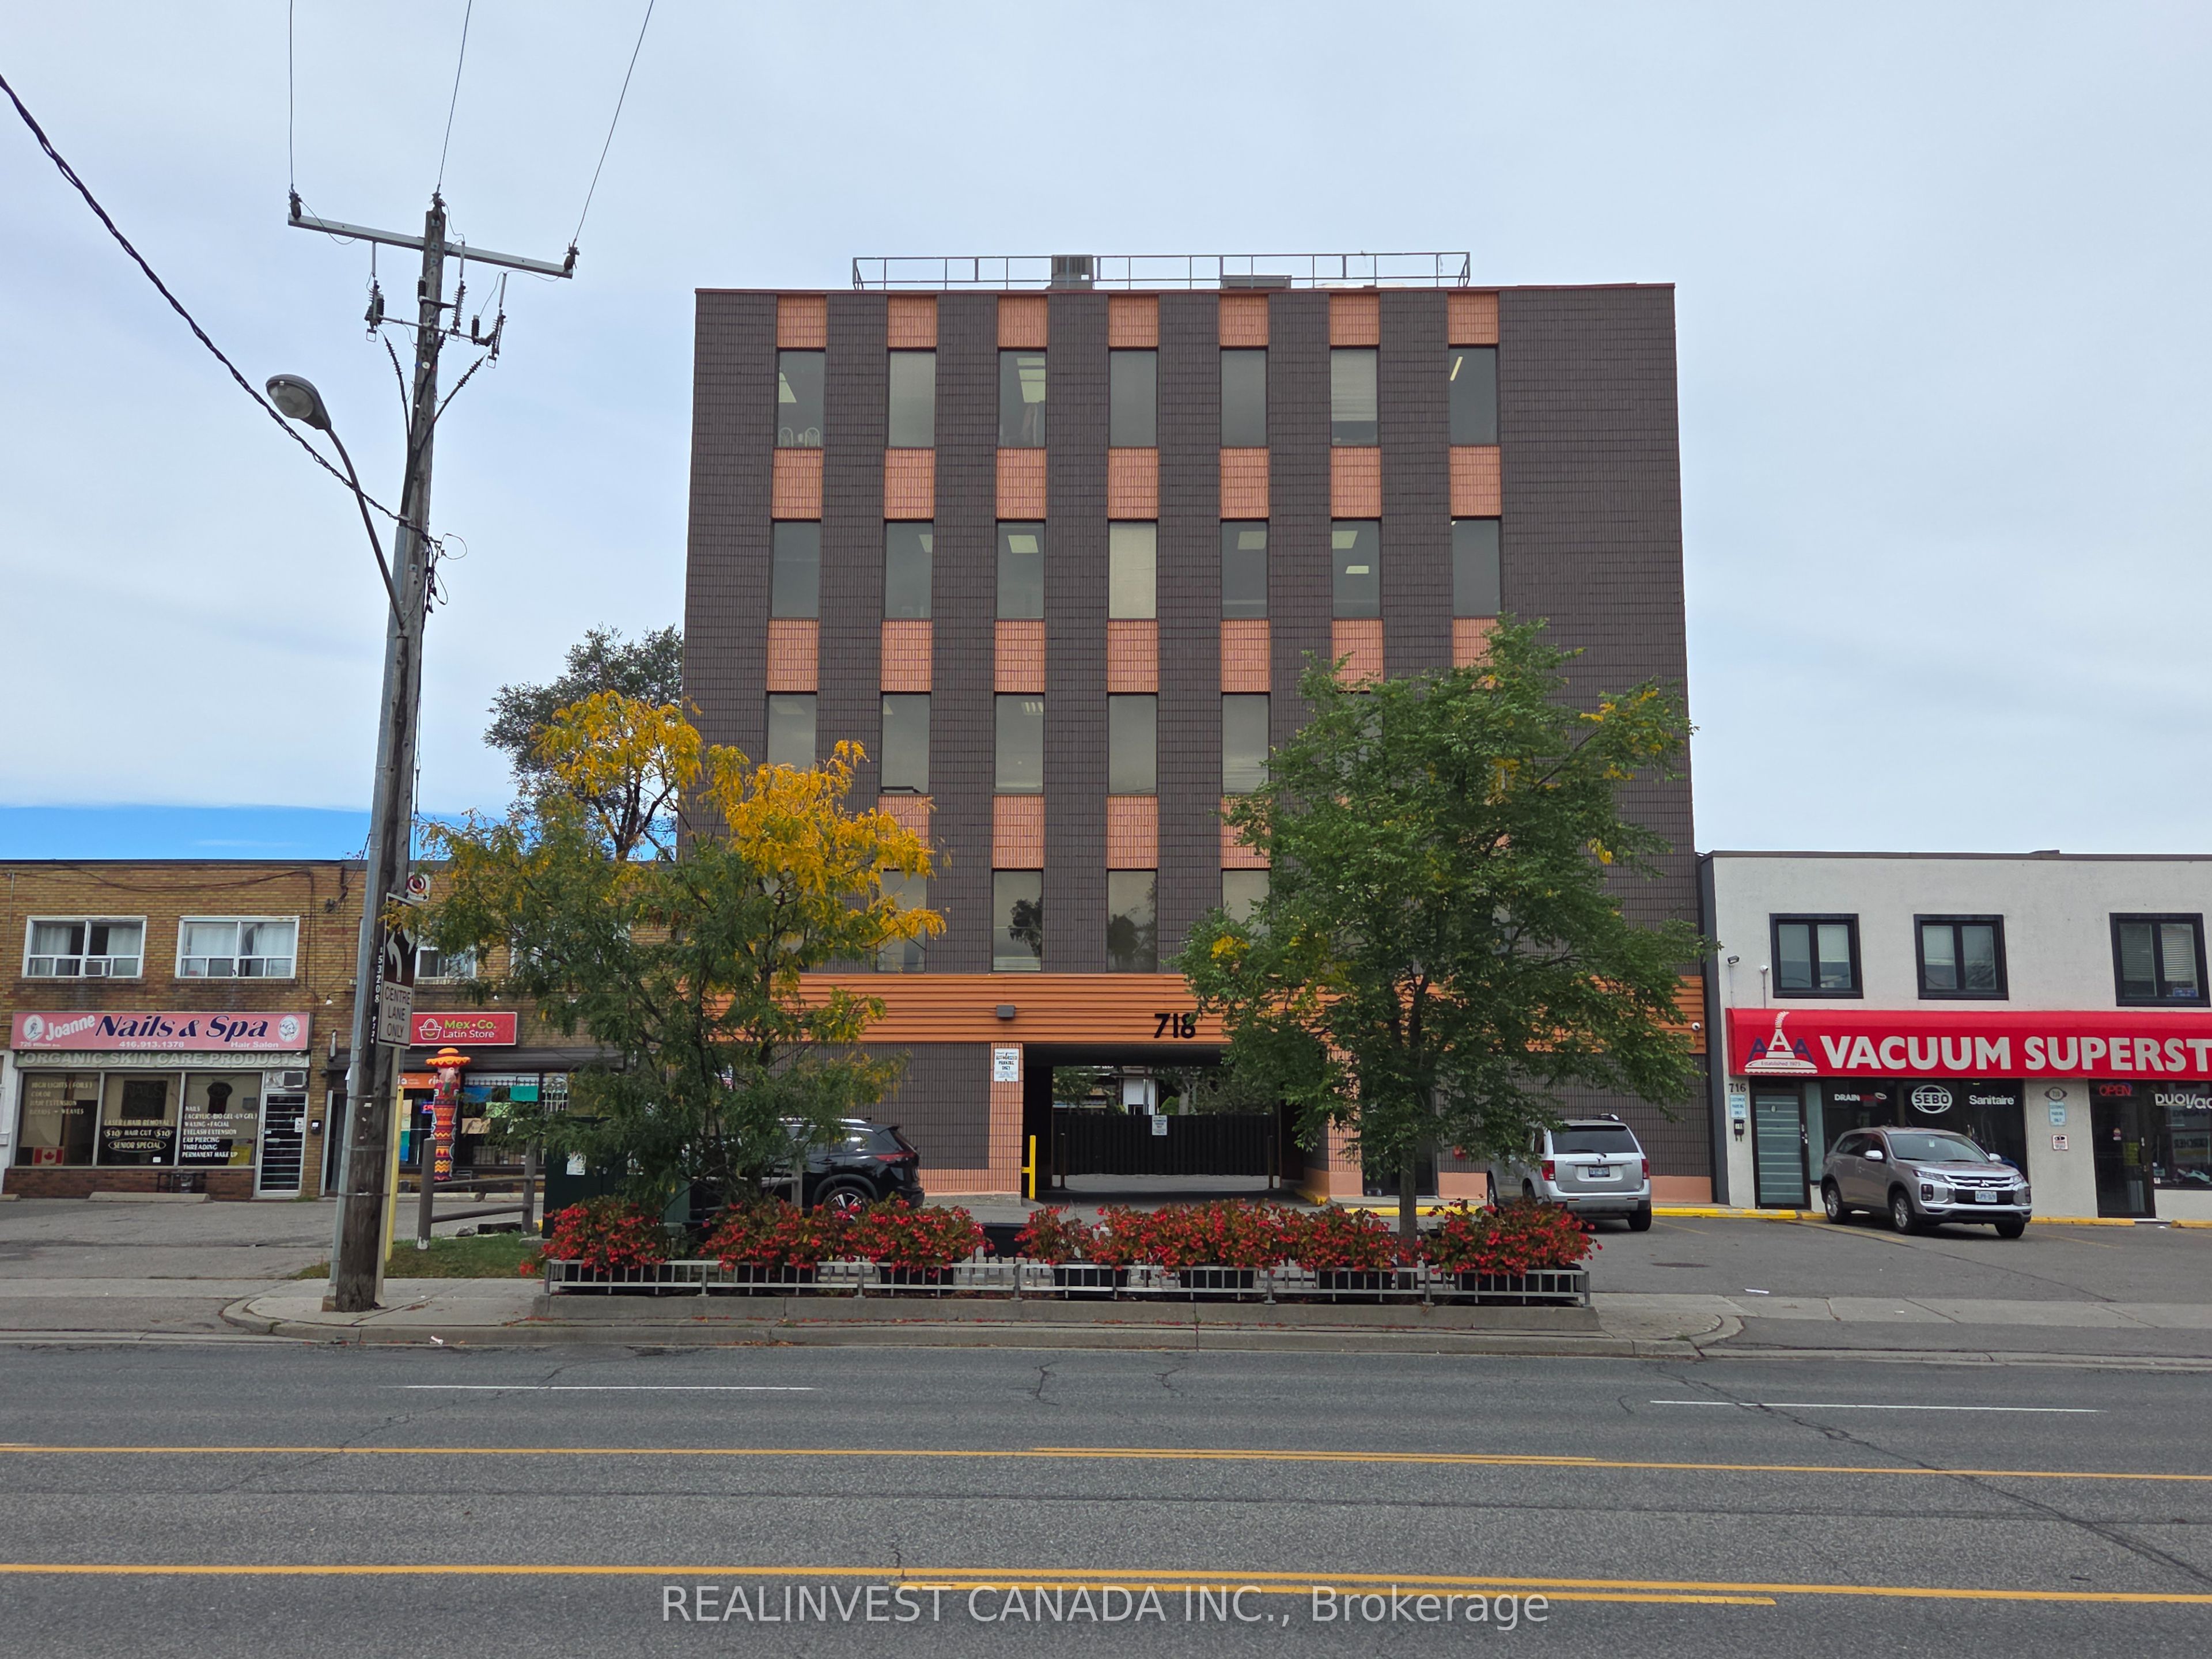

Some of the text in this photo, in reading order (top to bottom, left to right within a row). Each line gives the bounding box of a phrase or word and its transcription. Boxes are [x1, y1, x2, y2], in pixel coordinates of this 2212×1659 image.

[385, 986, 411, 1005] CENTRE
[388, 1005, 406, 1021] LANE
[46, 1015, 268, 1042] Joanne Nails & Spa
[387, 1023, 404, 1037] ONLY
[444, 1020, 470, 1029] Mex
[1154, 1013, 1196, 1039] 718
[443, 1030, 494, 1038] Latin Store
[1746, 1028, 1815, 1064] AAA
[24, 1052, 304, 1065] ORGANIC SKIN CARE PRODUCTS
[1820, 1035, 2212, 1072] VACUUM SUPERST
[1729, 1084, 1746, 1092] 716
[2099, 1084, 2131, 1096] OPEN
[1914, 1094, 1949, 1105] SEBO
[1969, 1095, 2014, 1105] Sanitaire
